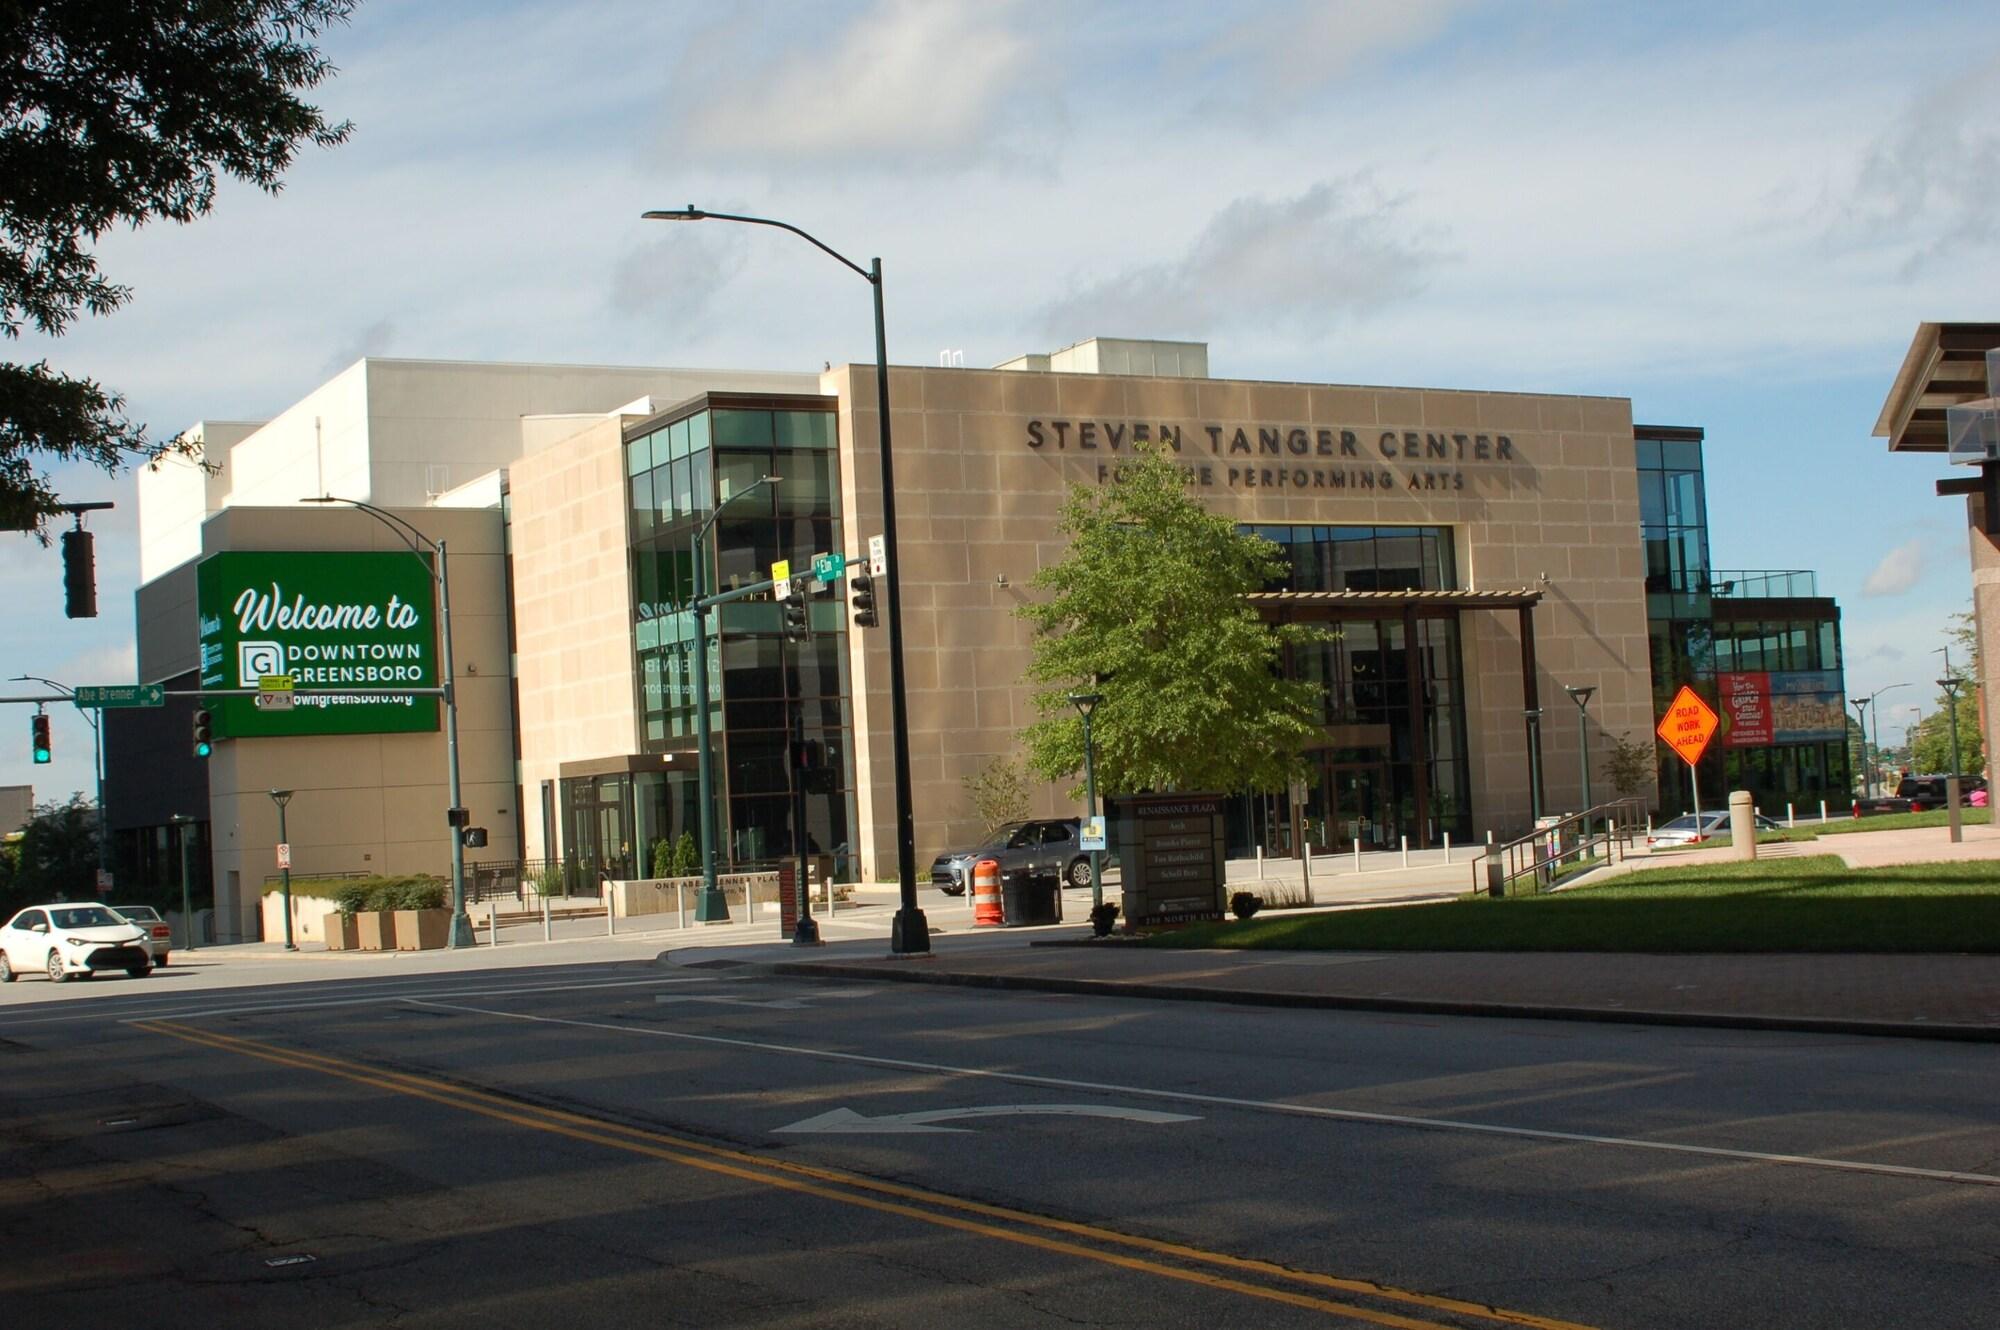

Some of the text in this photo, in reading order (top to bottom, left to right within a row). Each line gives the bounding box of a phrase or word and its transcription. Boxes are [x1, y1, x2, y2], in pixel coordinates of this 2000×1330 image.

[1026, 420, 1513, 460] STEVEN TANGER CENTER
[1228, 467, 1393, 490] PERFORMING
[1408, 472, 1464, 490] ARTS
[233, 581, 381, 633] Welcome
[386, 594, 418, 629] to
[288, 644, 420, 661] DOWNTOWN
[288, 665, 422, 683] GREENSBORO
[78, 687, 96, 700] Abe
[99, 687, 135, 700] Brenner
[1676, 706, 1699, 718] ROAD
[1677, 720, 1701, 732] WORK
[1677, 733, 1704, 746] AHEAD
[1138, 803, 1216, 815] RENAISSANCE PLAZA
[655, 874, 780, 890] ONE ABE ENNER PLAC
